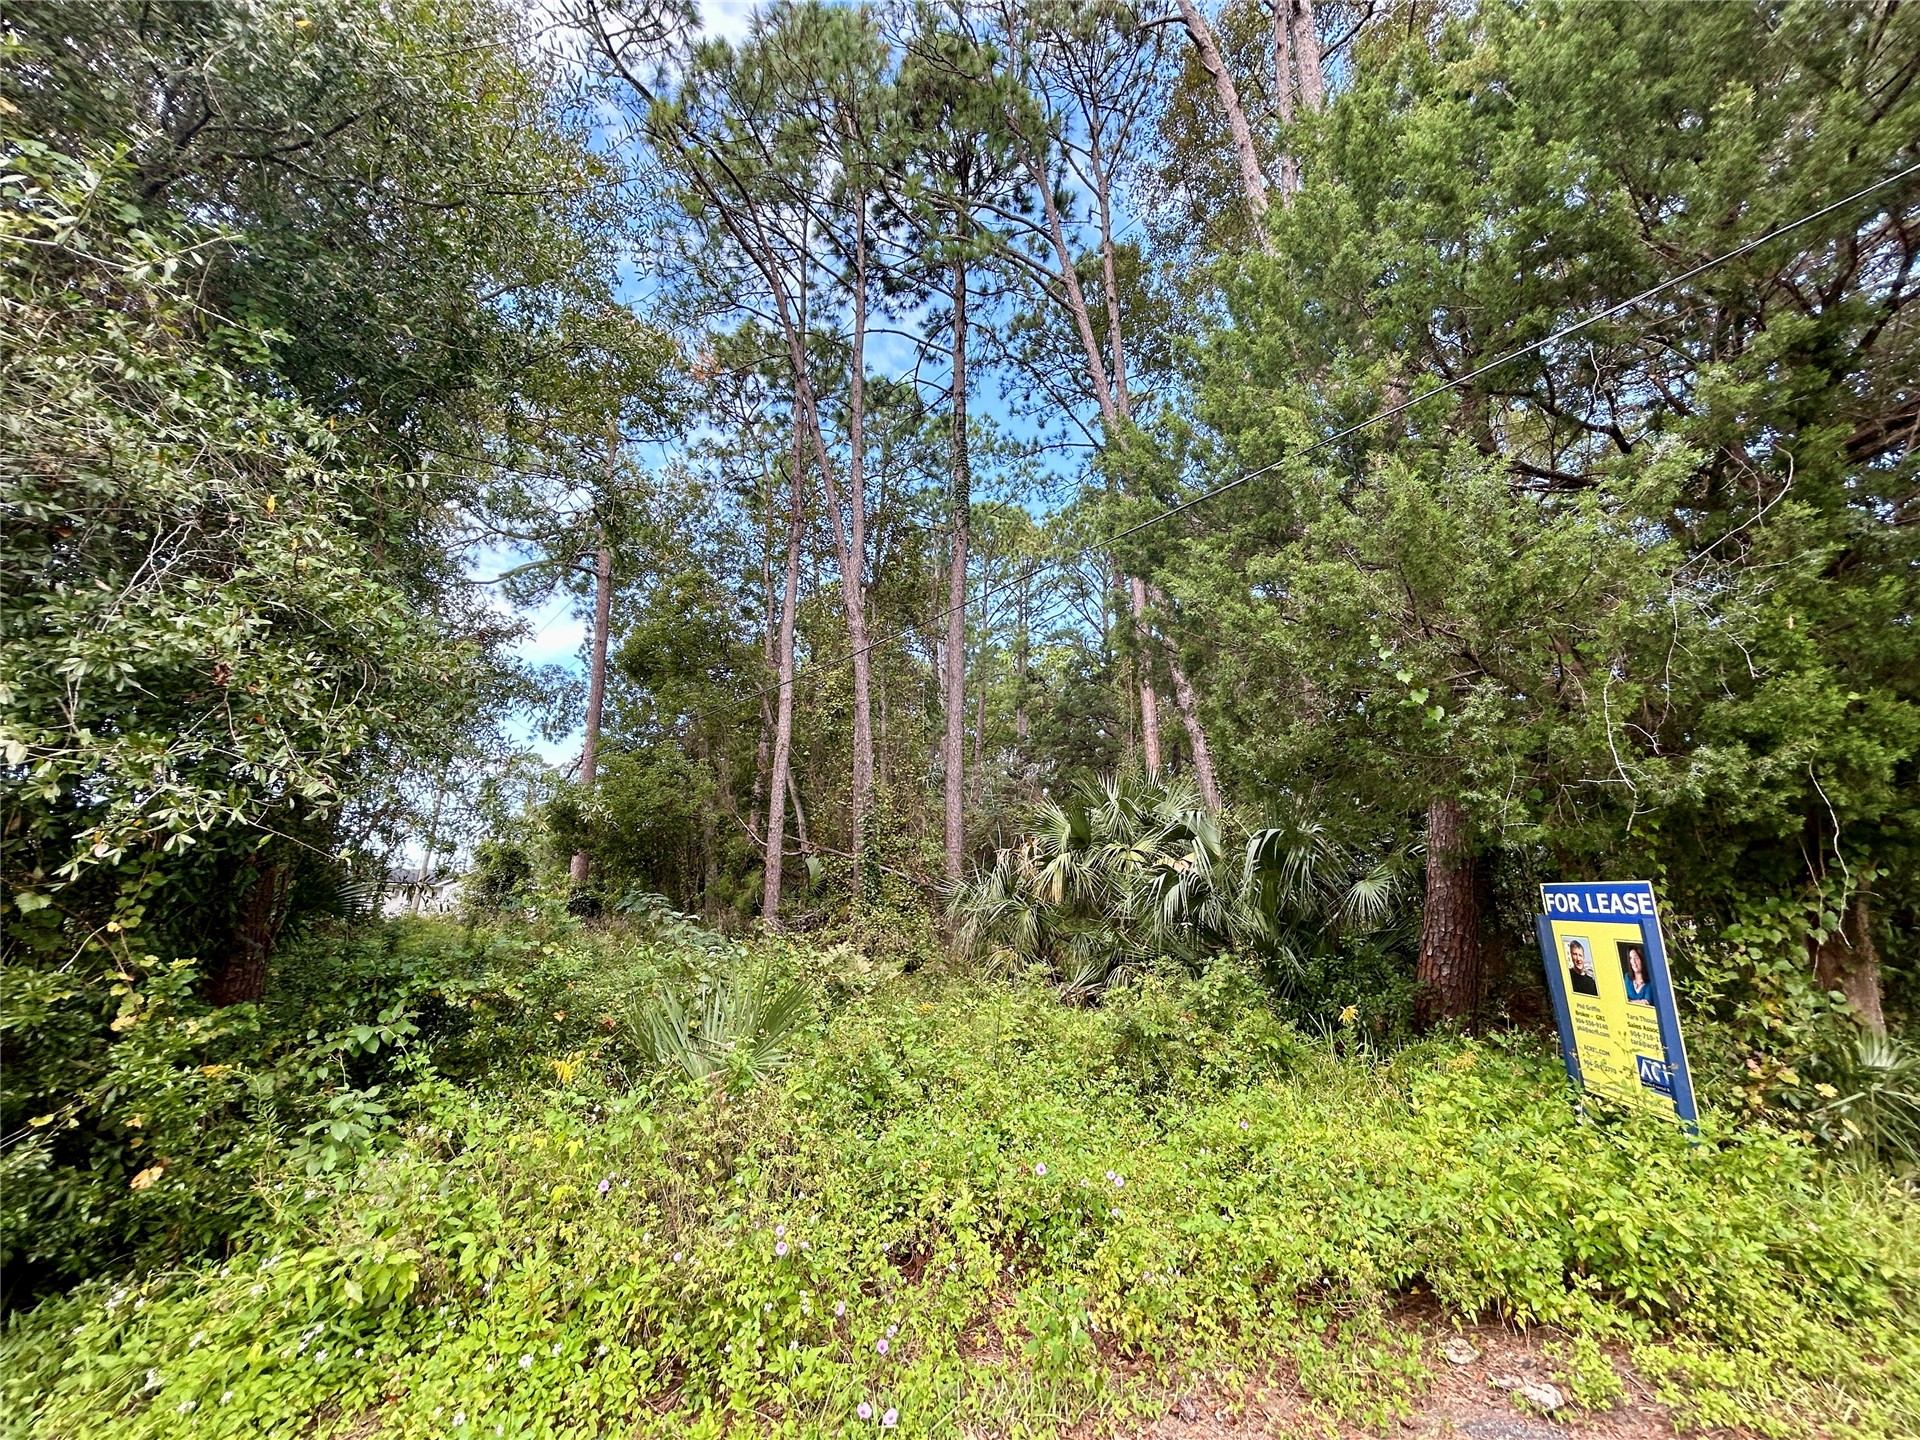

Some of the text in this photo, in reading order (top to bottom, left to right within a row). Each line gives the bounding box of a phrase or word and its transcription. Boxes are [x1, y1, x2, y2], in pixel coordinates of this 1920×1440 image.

[1545, 892, 1654, 915] FOR LEASE
[1575, 1010, 1590, 1018] Broker
[1626, 1013, 1639, 1021] Tara
[1627, 1021, 1642, 1030] Sales
